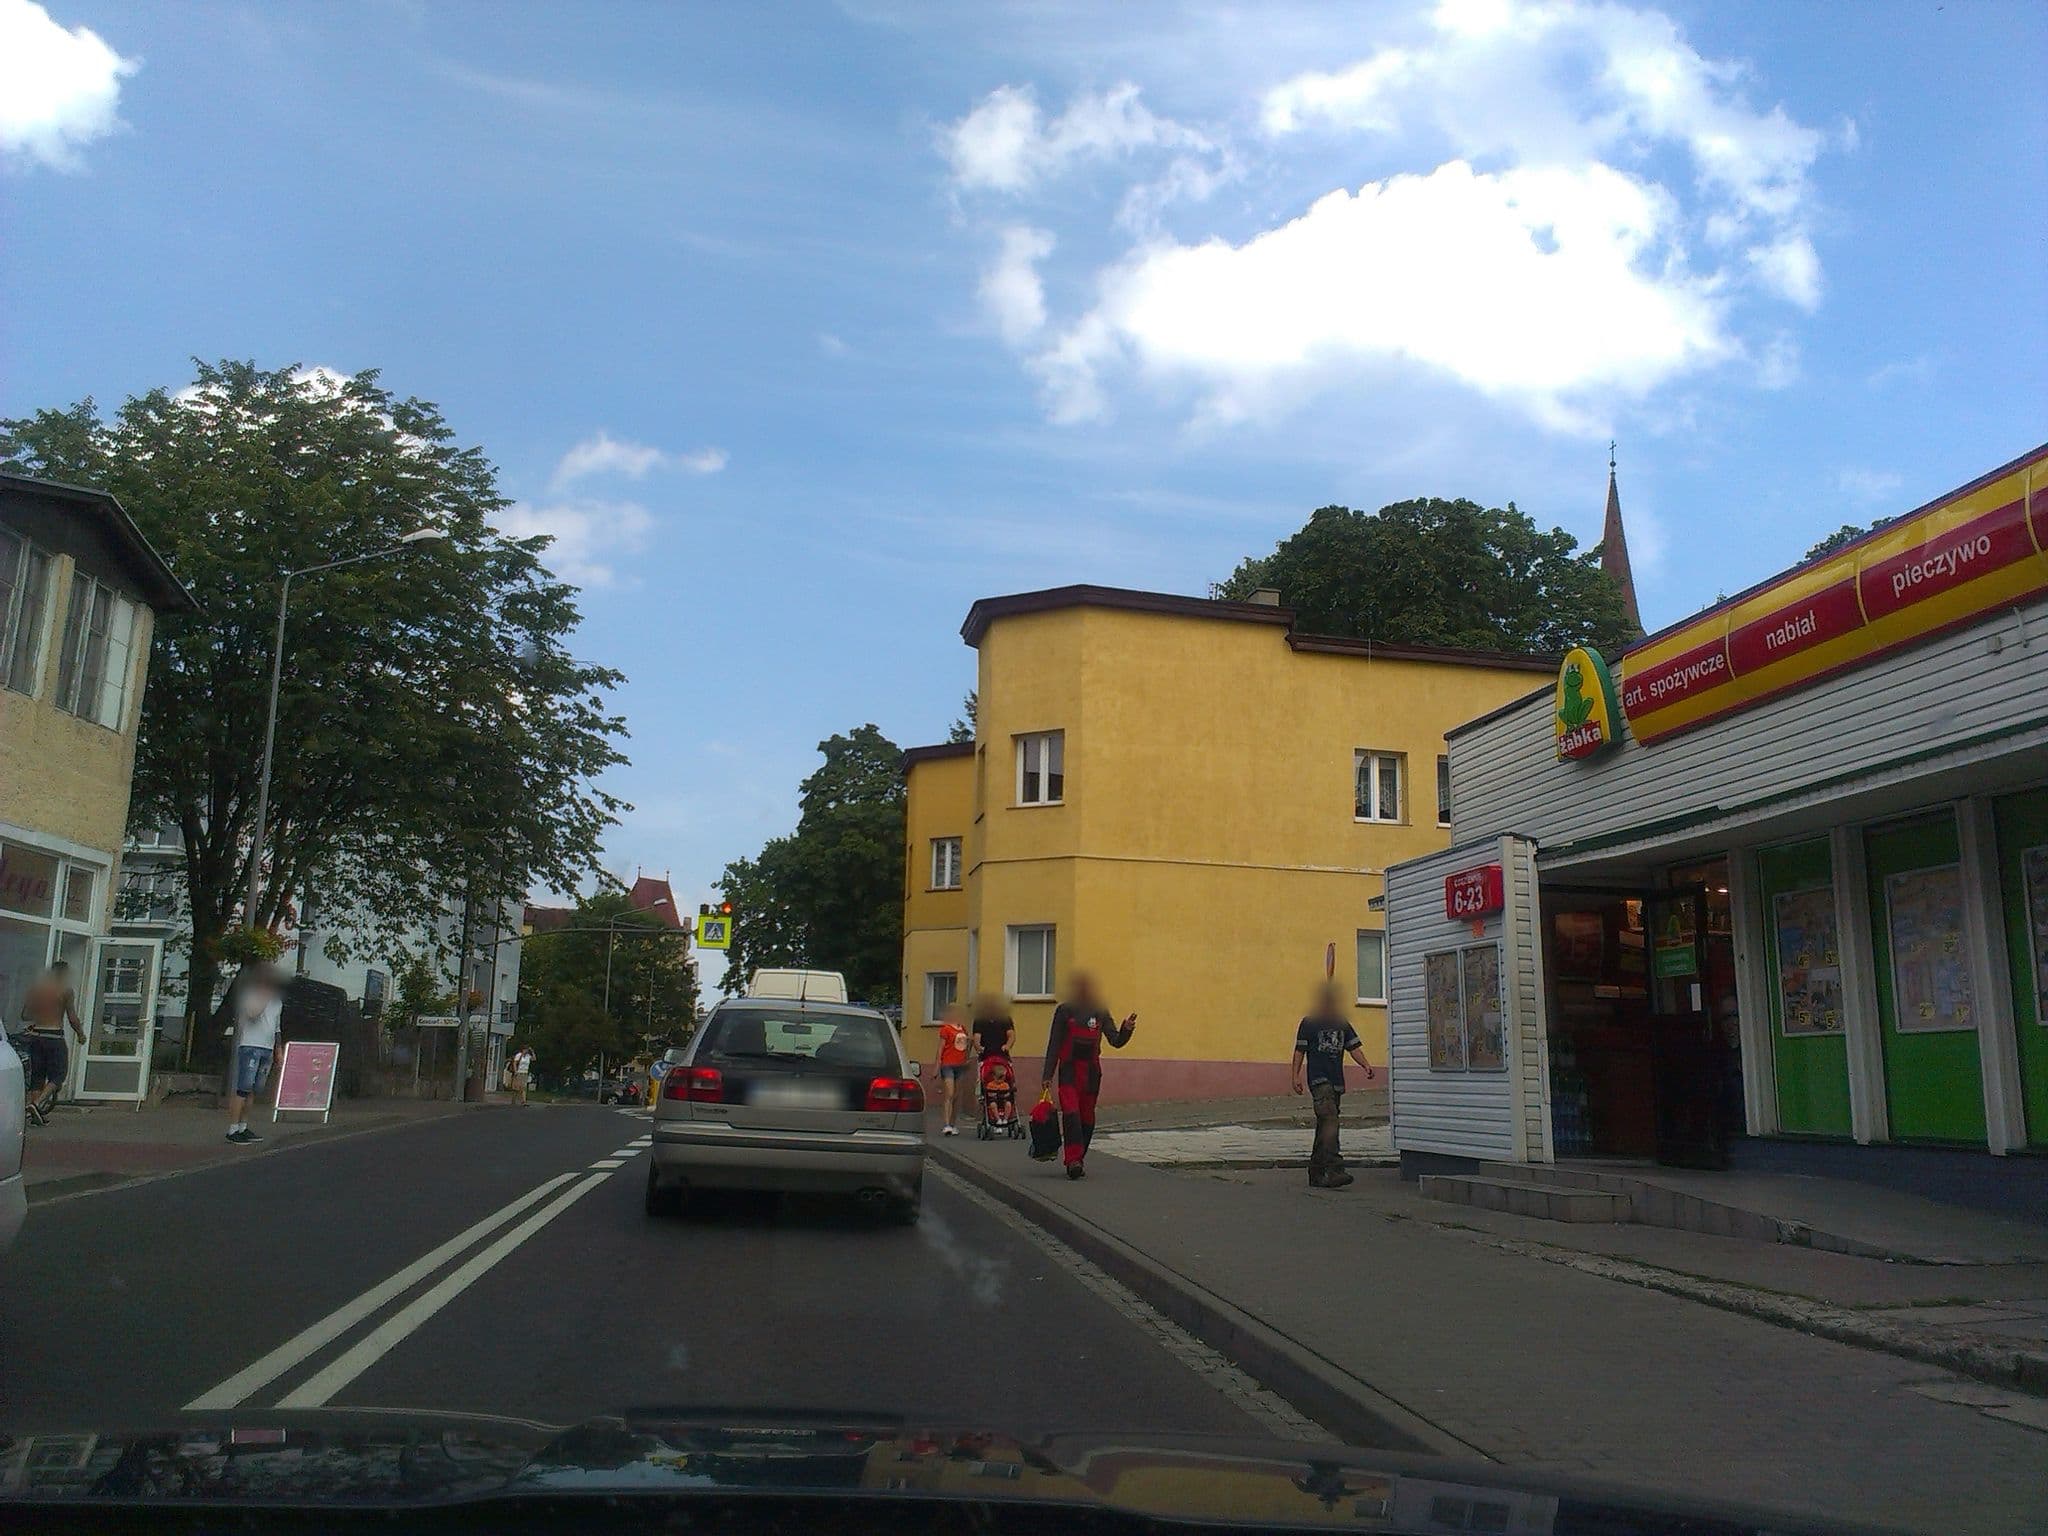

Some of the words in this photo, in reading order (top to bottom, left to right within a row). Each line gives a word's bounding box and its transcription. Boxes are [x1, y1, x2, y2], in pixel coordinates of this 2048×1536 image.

[1891, 535, 1991, 598] pieczywo
[1765, 609, 1817, 650] nabiał
[1625, 685, 1647, 708] art.
[1649, 653, 1725, 699] spożywcze
[1559, 727, 1602, 754] żabka
[1455, 885, 1484, 913] 6-23
